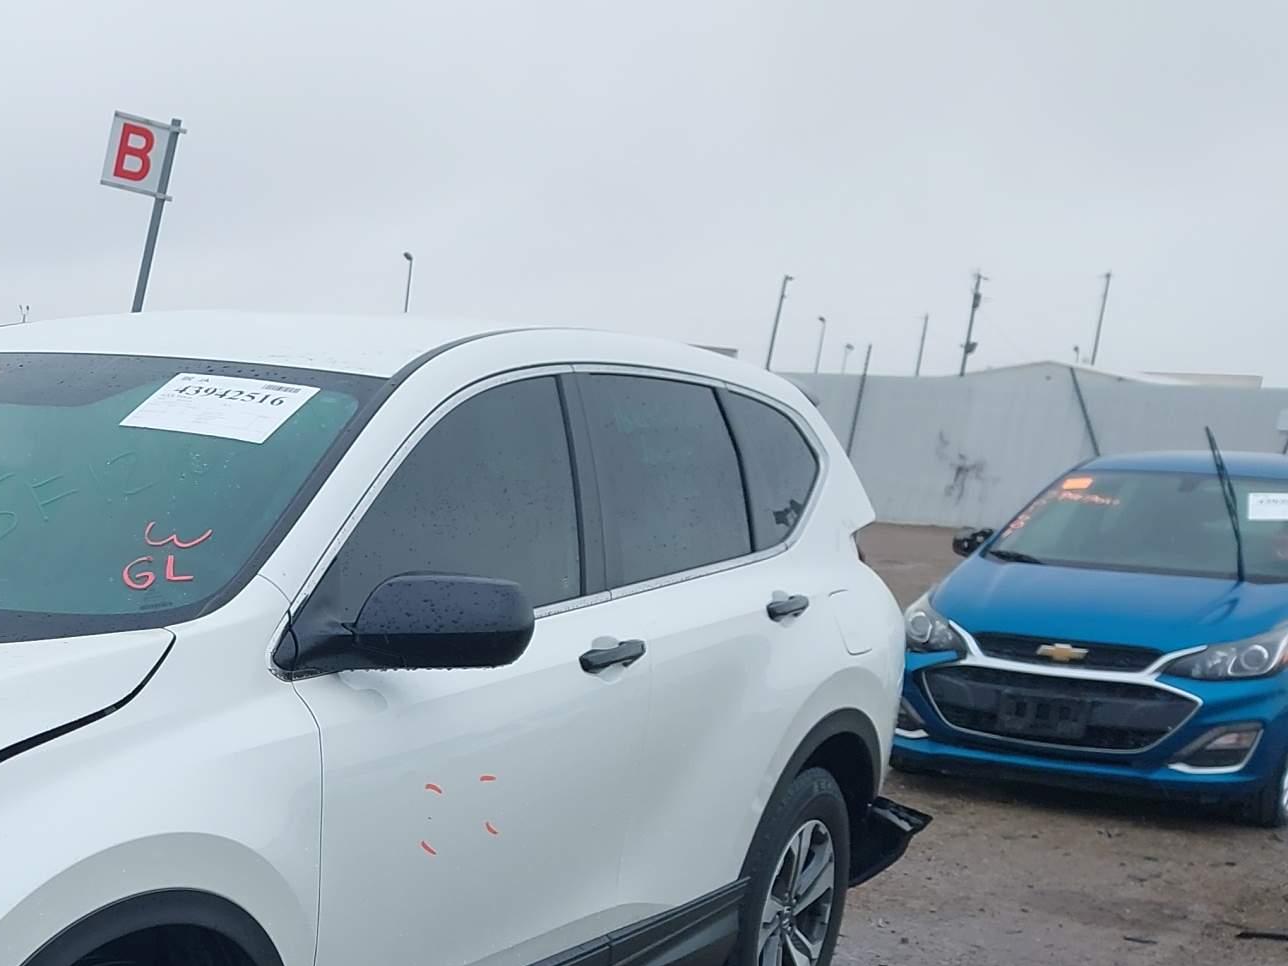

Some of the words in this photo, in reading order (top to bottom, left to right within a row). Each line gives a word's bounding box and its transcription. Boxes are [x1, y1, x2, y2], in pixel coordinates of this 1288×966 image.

[113, 122, 155, 182] B
[174, 384, 285, 407] 43942516
[122, 554, 195, 590] GL
